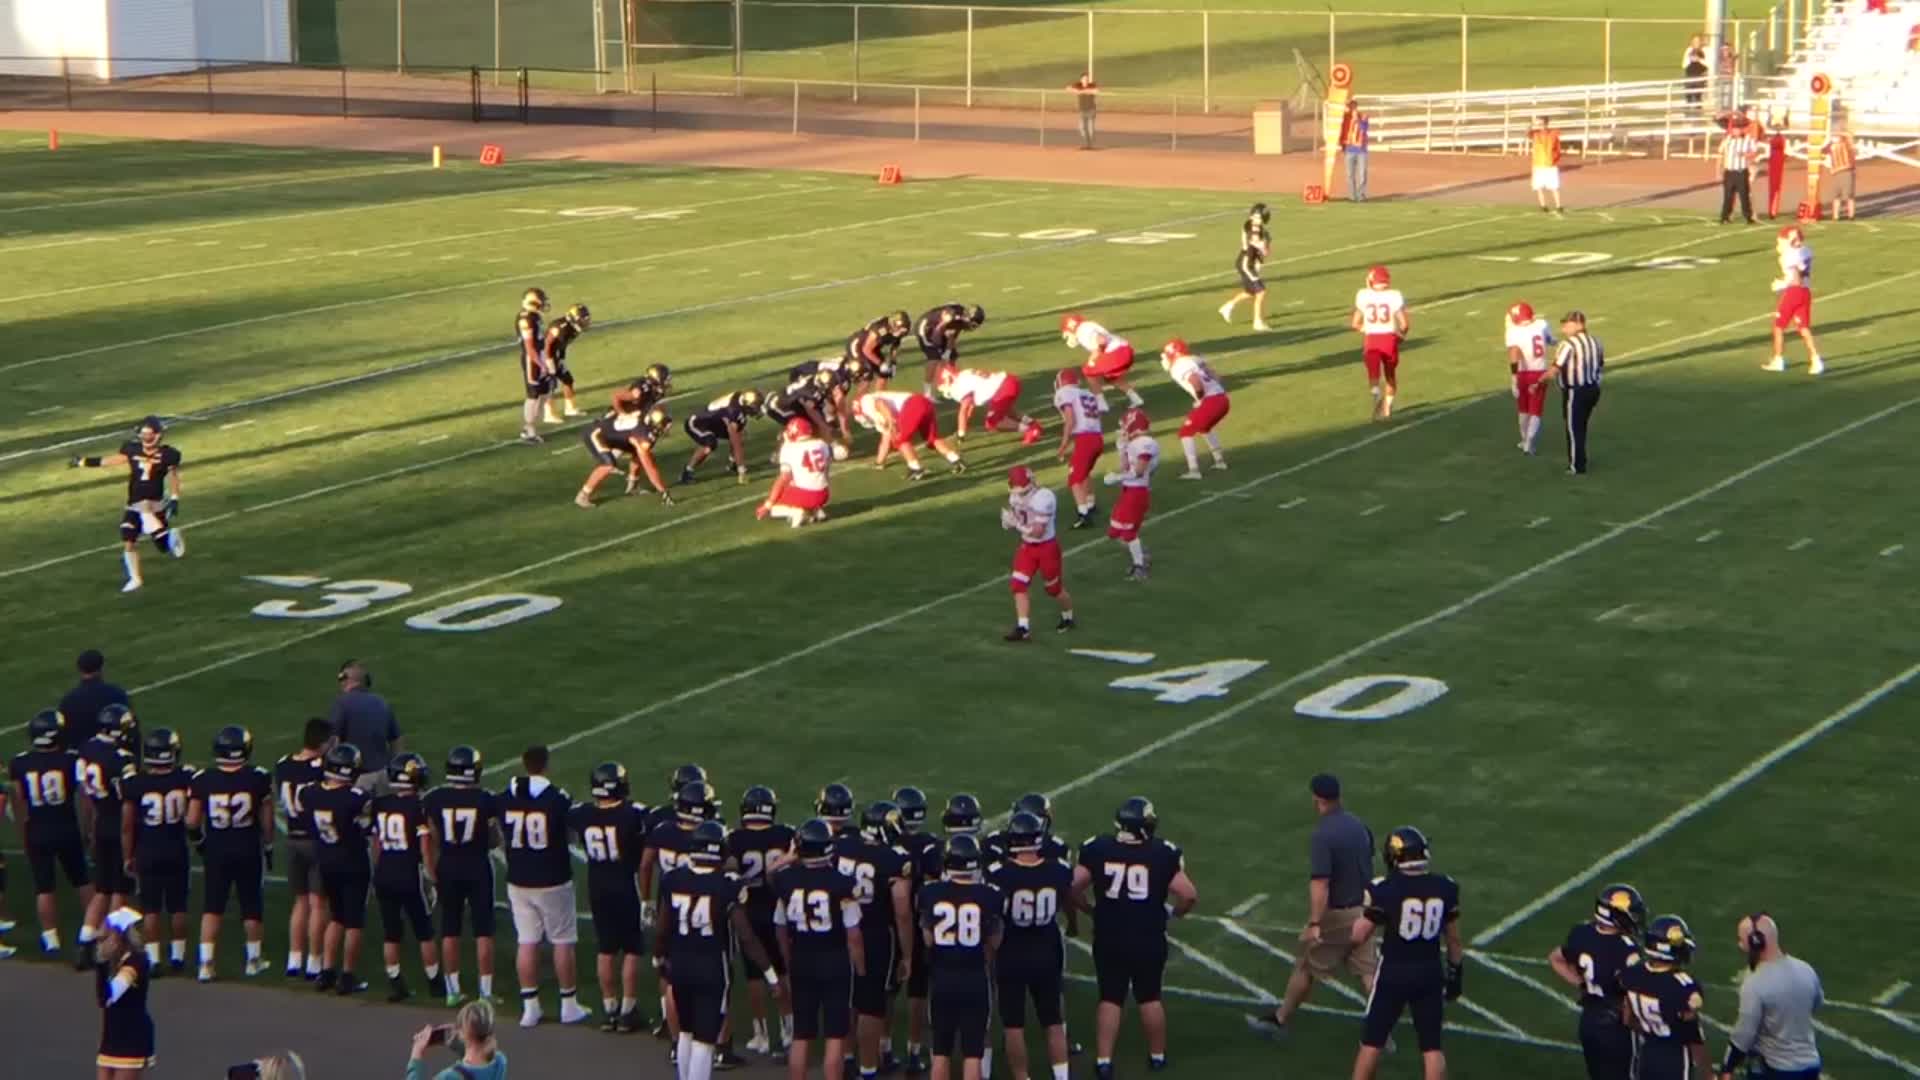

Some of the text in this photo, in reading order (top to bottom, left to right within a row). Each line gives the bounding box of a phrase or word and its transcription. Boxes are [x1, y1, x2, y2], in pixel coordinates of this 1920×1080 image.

[1366, 304, 1390, 323] 33
[1532, 335, 1545, 357] 6
[802, 449, 827, 473] 42
[141, 789, 186, 826] 30
[208, 791, 252, 829] 52
[442, 808, 477, 844] 17
[313, 810, 338, 844] 5
[377, 812, 408, 850] 19
[505, 811, 548, 850] 78
[584, 825, 620, 862] 61
[1104, 862, 1149, 900] 79
[671, 892, 714, 936] 74
[787, 888, 833, 932] 43
[933, 902, 981, 947] 28
[1011, 888, 1057, 927] 60
[1400, 898, 1444, 942] 68
[1578, 953, 1604, 997] 2
[1627, 990, 1671, 1037] 15
